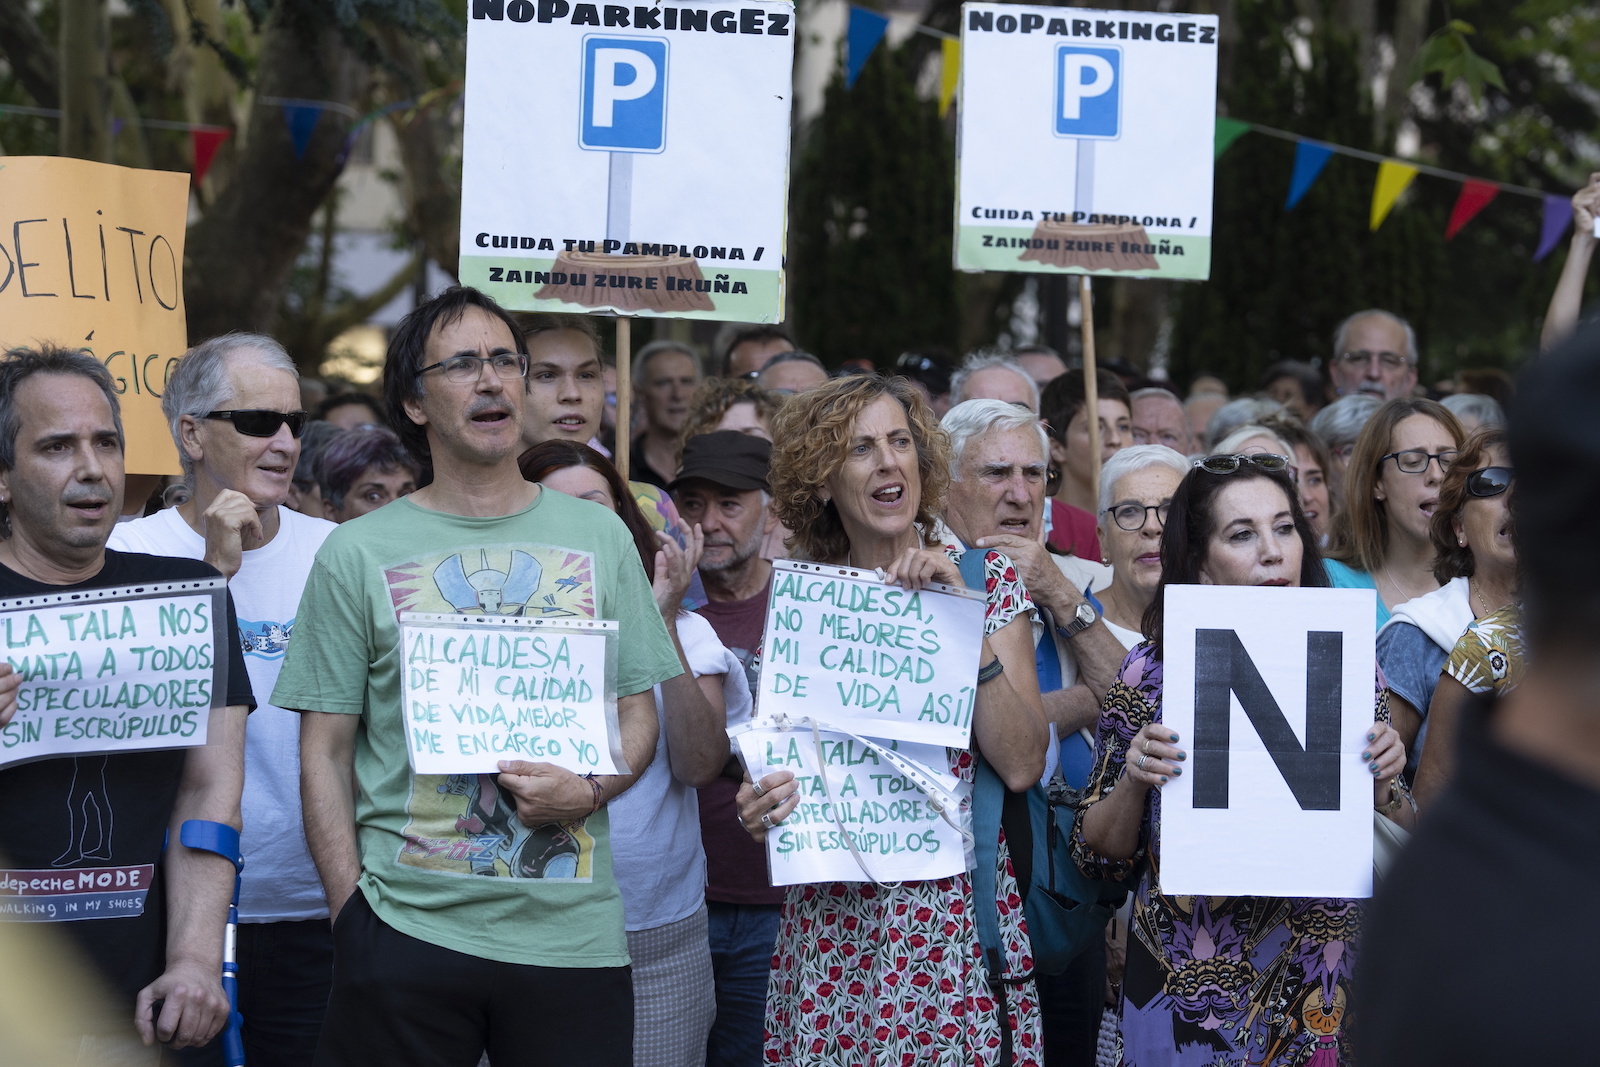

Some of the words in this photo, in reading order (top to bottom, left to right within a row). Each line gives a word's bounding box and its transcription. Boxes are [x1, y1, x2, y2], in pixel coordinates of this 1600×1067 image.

[592, 48, 657, 128] P
[1062, 53, 1114, 120] P
[6, 613, 49, 649] LA
[60, 605, 137, 641] TALA
[159, 602, 209, 637] NOS
[774, 605, 803, 632] NO
[819, 613, 941, 655] MEJORES
[7, 650, 83, 682] MATA
[97, 647, 116, 679] A
[408, 632, 584, 675] ALCALDESA,
[770, 637, 799, 665] MI
[819, 645, 935, 684] CALIDAD
[17, 679, 211, 711] SPECULADORES
[410, 667, 440, 692] DE
[770, 672, 809, 698] DE
[836, 679, 901, 713] VIDA
[55, 710, 198, 740] ESCRÚPULOS
[413, 700, 441, 723] DE
[1192, 628, 1343, 811] N
[413, 727, 444, 754] ME
[569, 737, 599, 766] YO
[766, 737, 803, 768] LA
[840, 773, 858, 798] A
[85, 899, 101, 911] MY
[108, 897, 142, 909] SHOES
